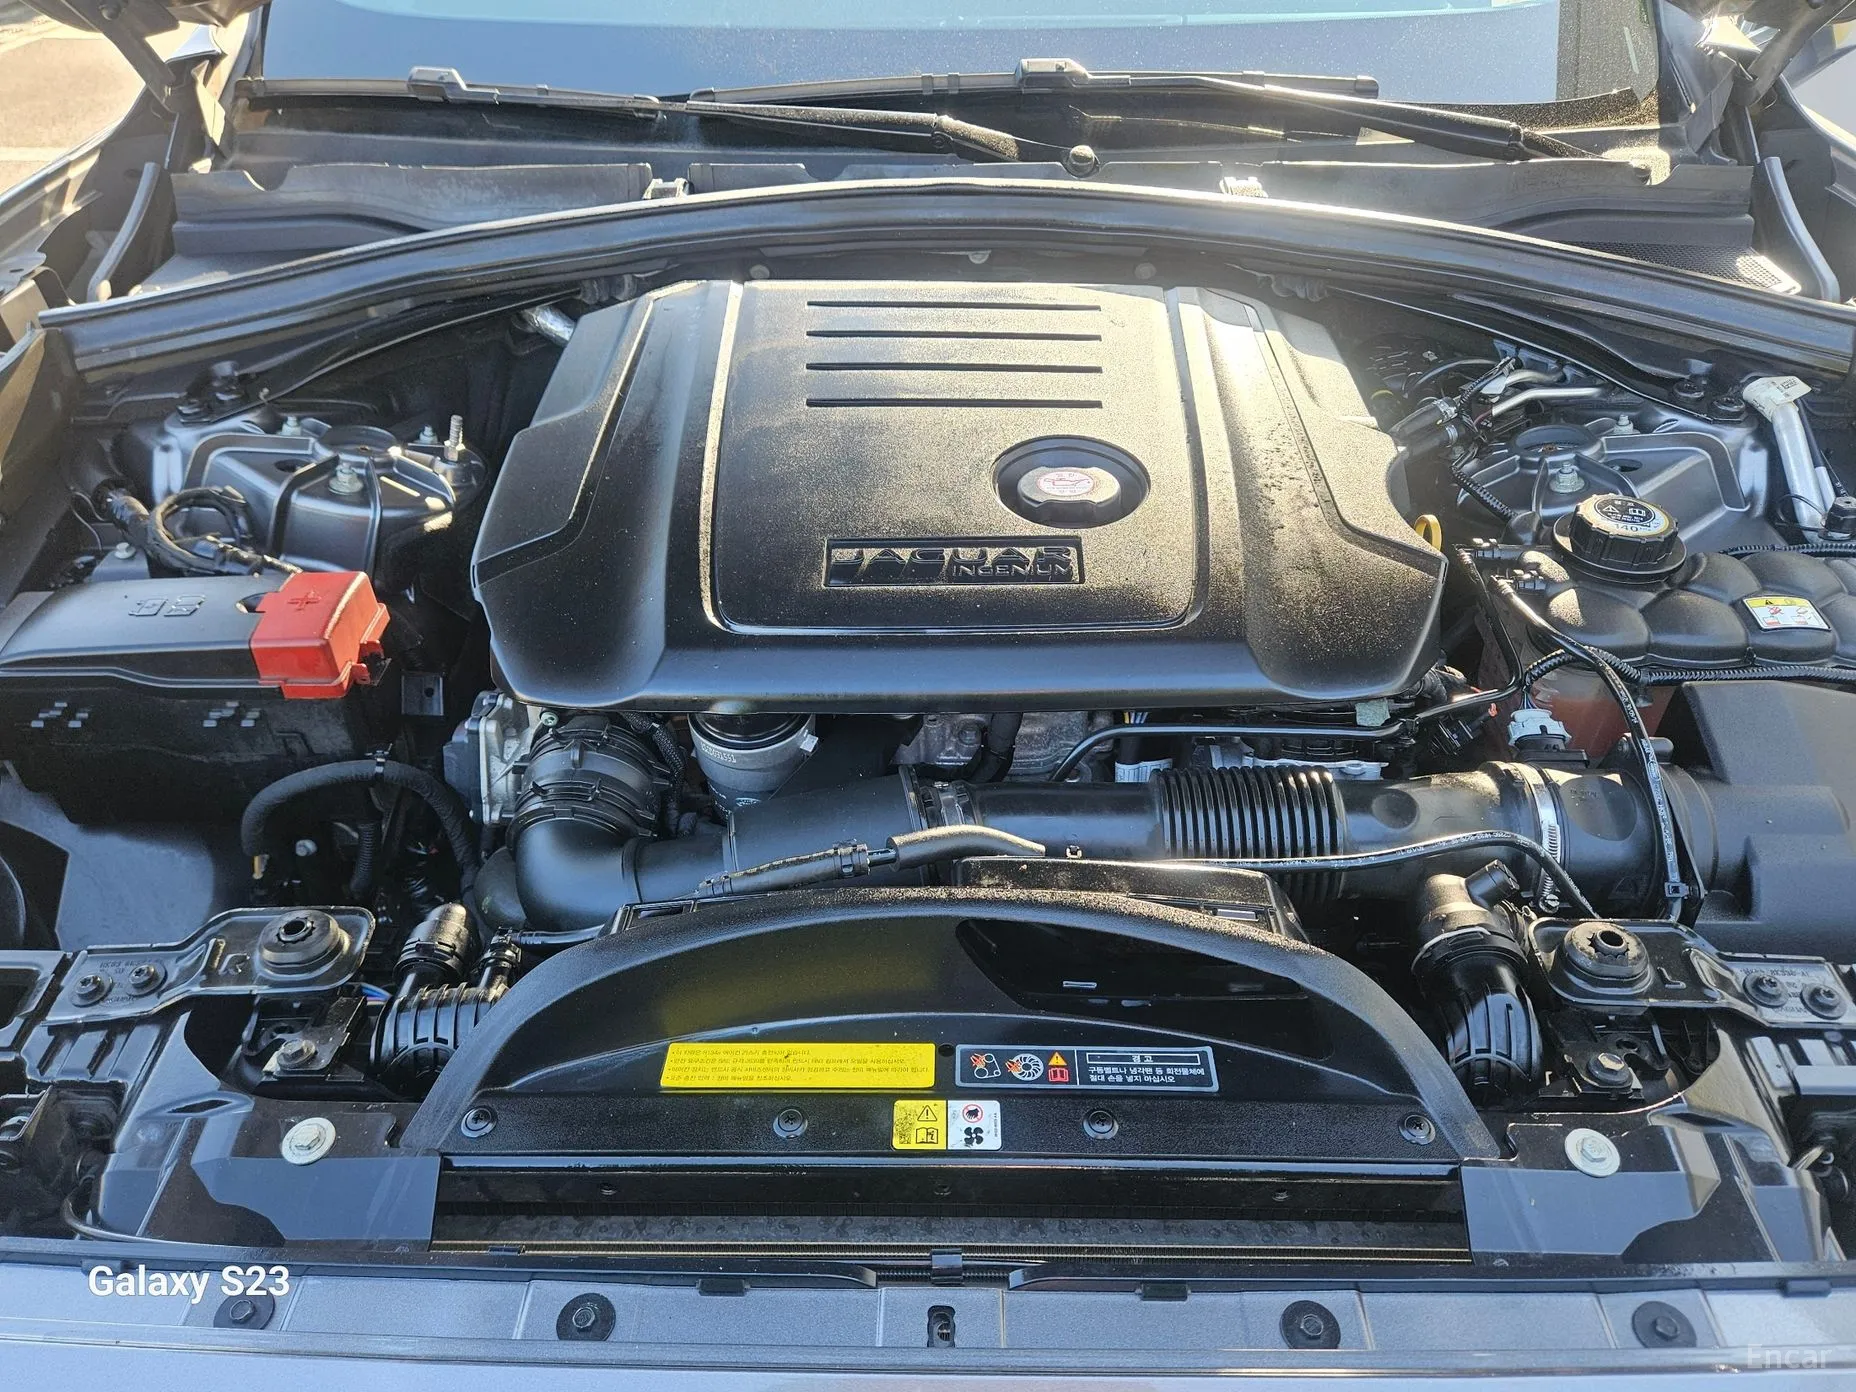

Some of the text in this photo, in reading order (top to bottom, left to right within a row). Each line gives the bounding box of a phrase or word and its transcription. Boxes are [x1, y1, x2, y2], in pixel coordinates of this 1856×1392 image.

[831, 546, 1072, 564] JAGUAR
[952, 564, 1073, 577] INGENIUM
[1088, 1066, 1127, 1075] 구동벨트나
[1155, 1067, 1164, 1075] 등
[1090, 1074, 1105, 1082] 절대
[1107, 1074, 1124, 1083] 손을
[1126, 1075, 1142, 1083] 넣지
